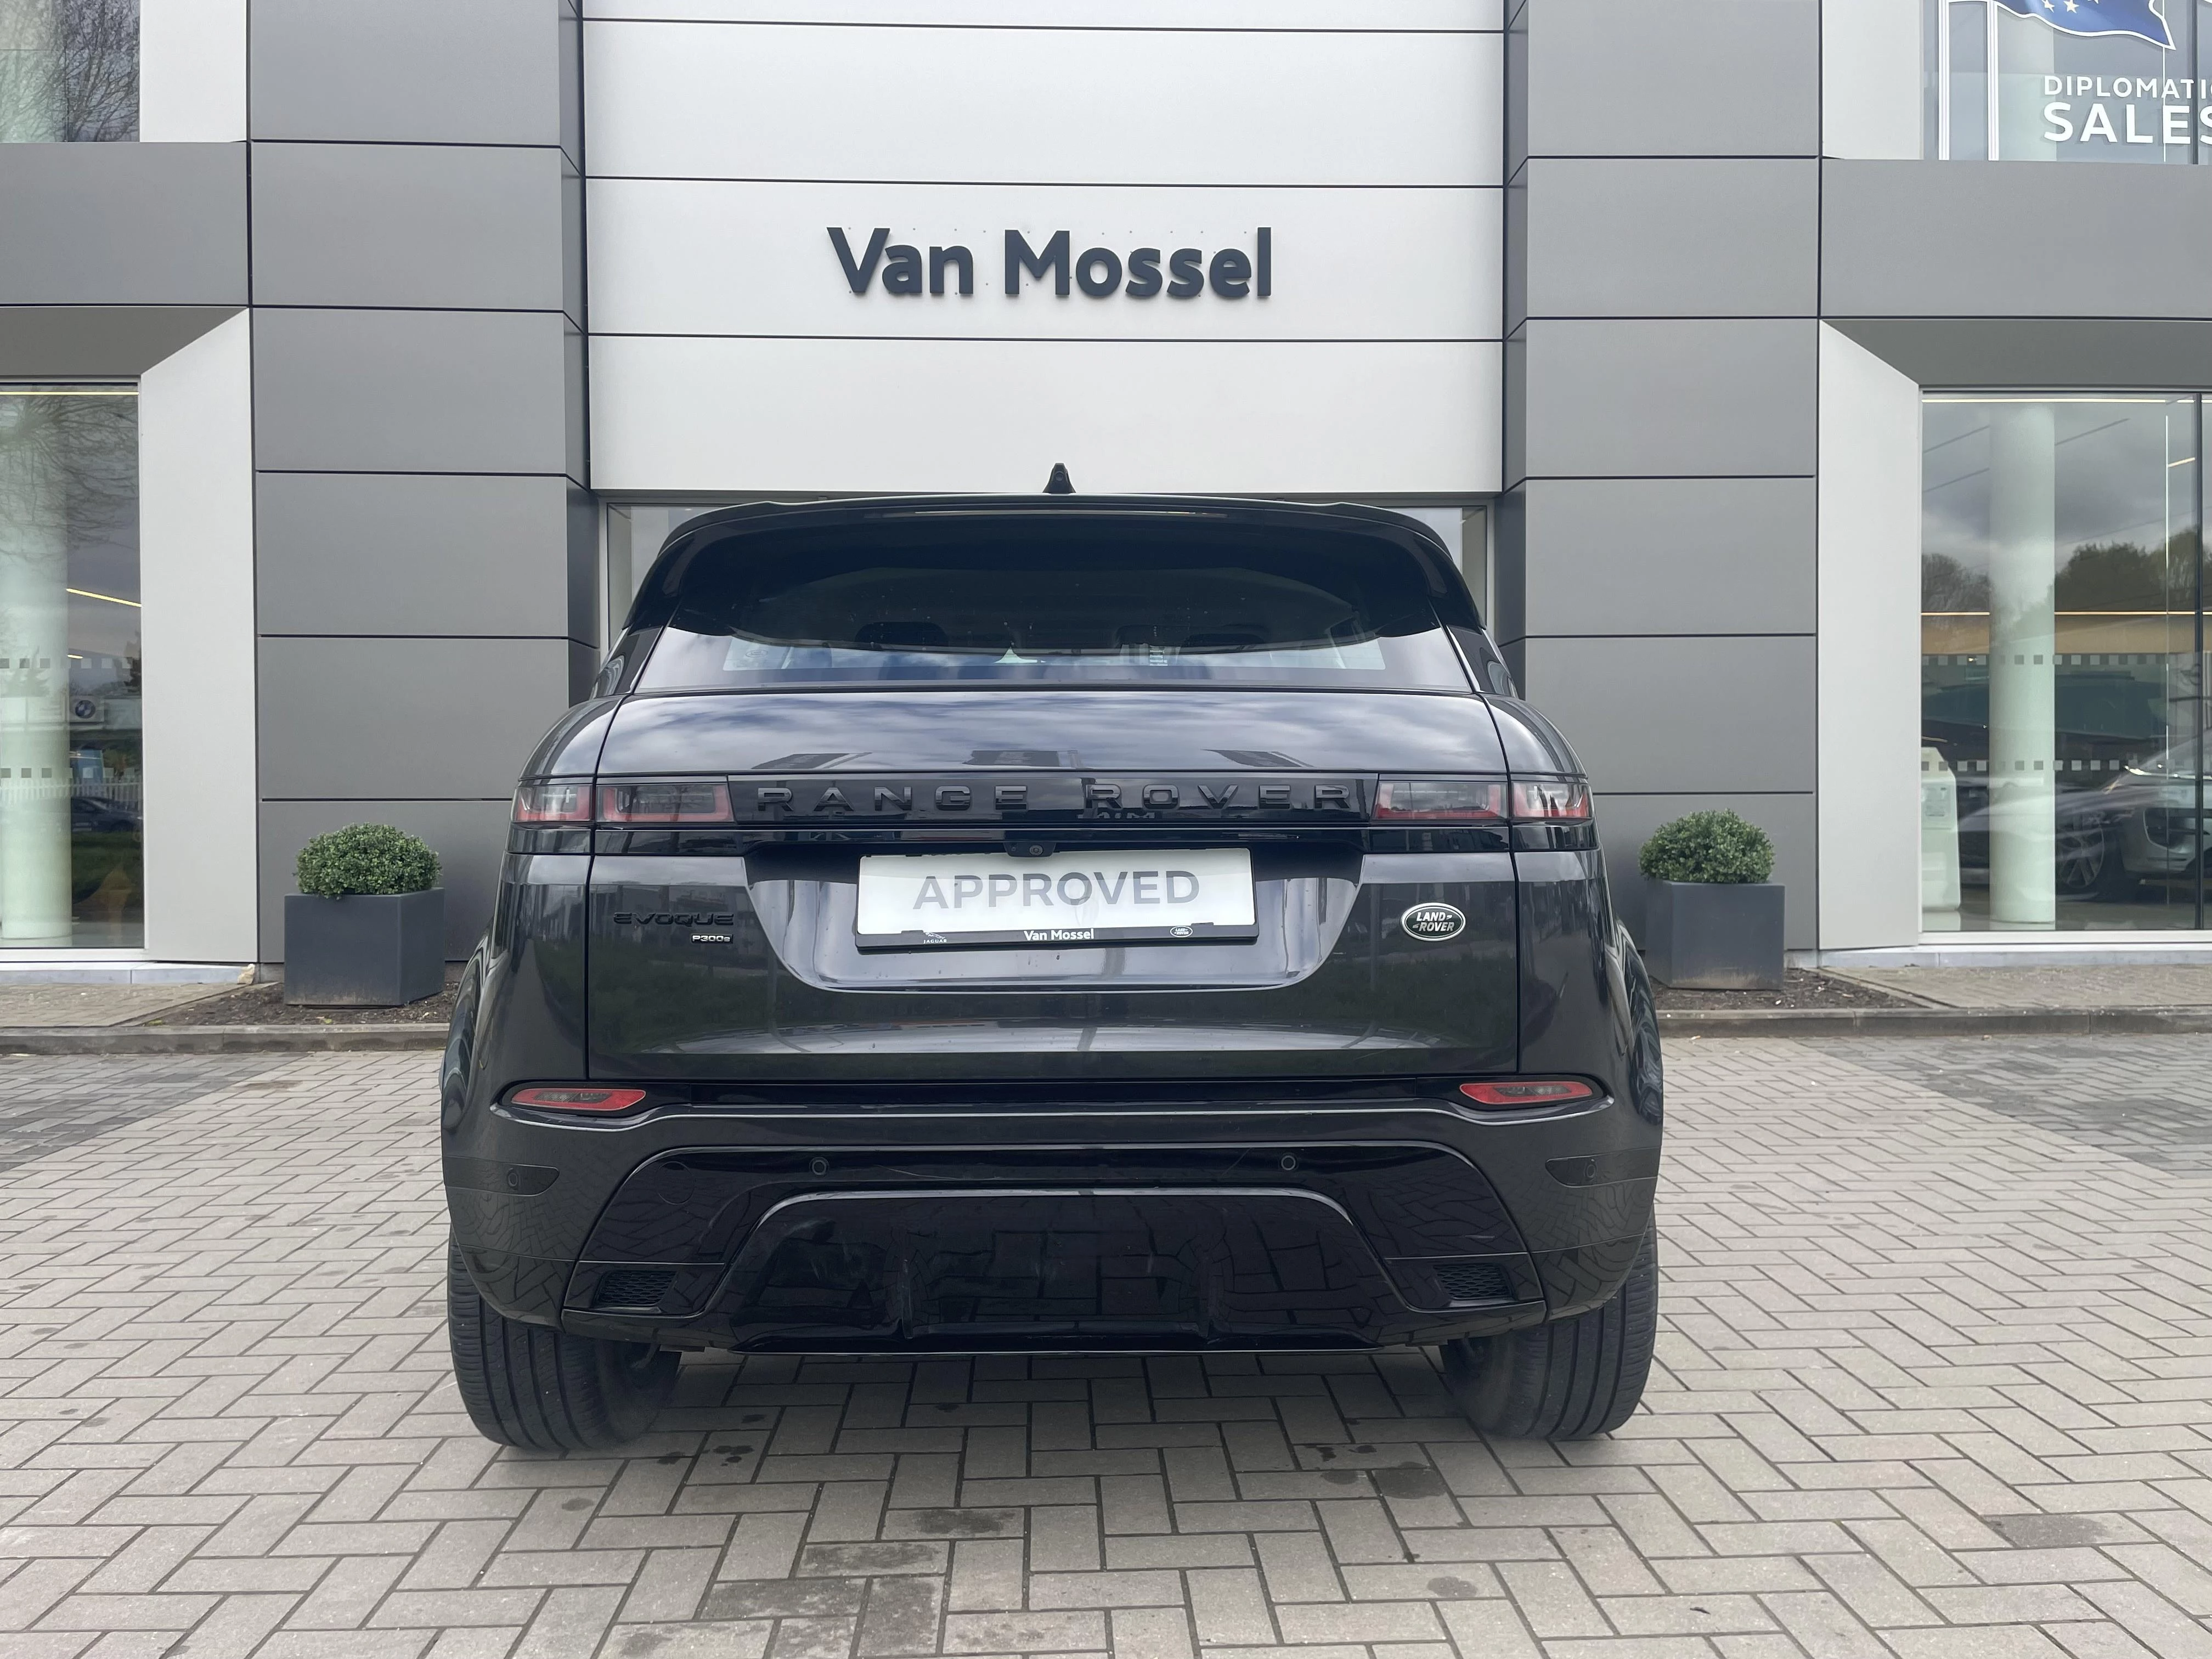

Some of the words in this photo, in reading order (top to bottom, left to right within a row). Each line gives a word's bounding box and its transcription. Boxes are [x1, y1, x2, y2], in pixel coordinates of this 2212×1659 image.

[2044, 76, 2212, 99] DIPLOMATI
[827, 227, 974, 295] Van
[1005, 227, 1272, 298] Mossel
[757, 785, 1029, 812] RANGE
[1084, 783, 1351, 810] ROVER
[913, 870, 1200, 910] APPROVED
[613, 912, 734, 927] EVOQUE
[1417, 912, 1446, 922] LAND
[1024, 930, 1047, 940] Van
[1051, 928, 1094, 940] Mossel
[1419, 922, 1455, 932] ROVER
